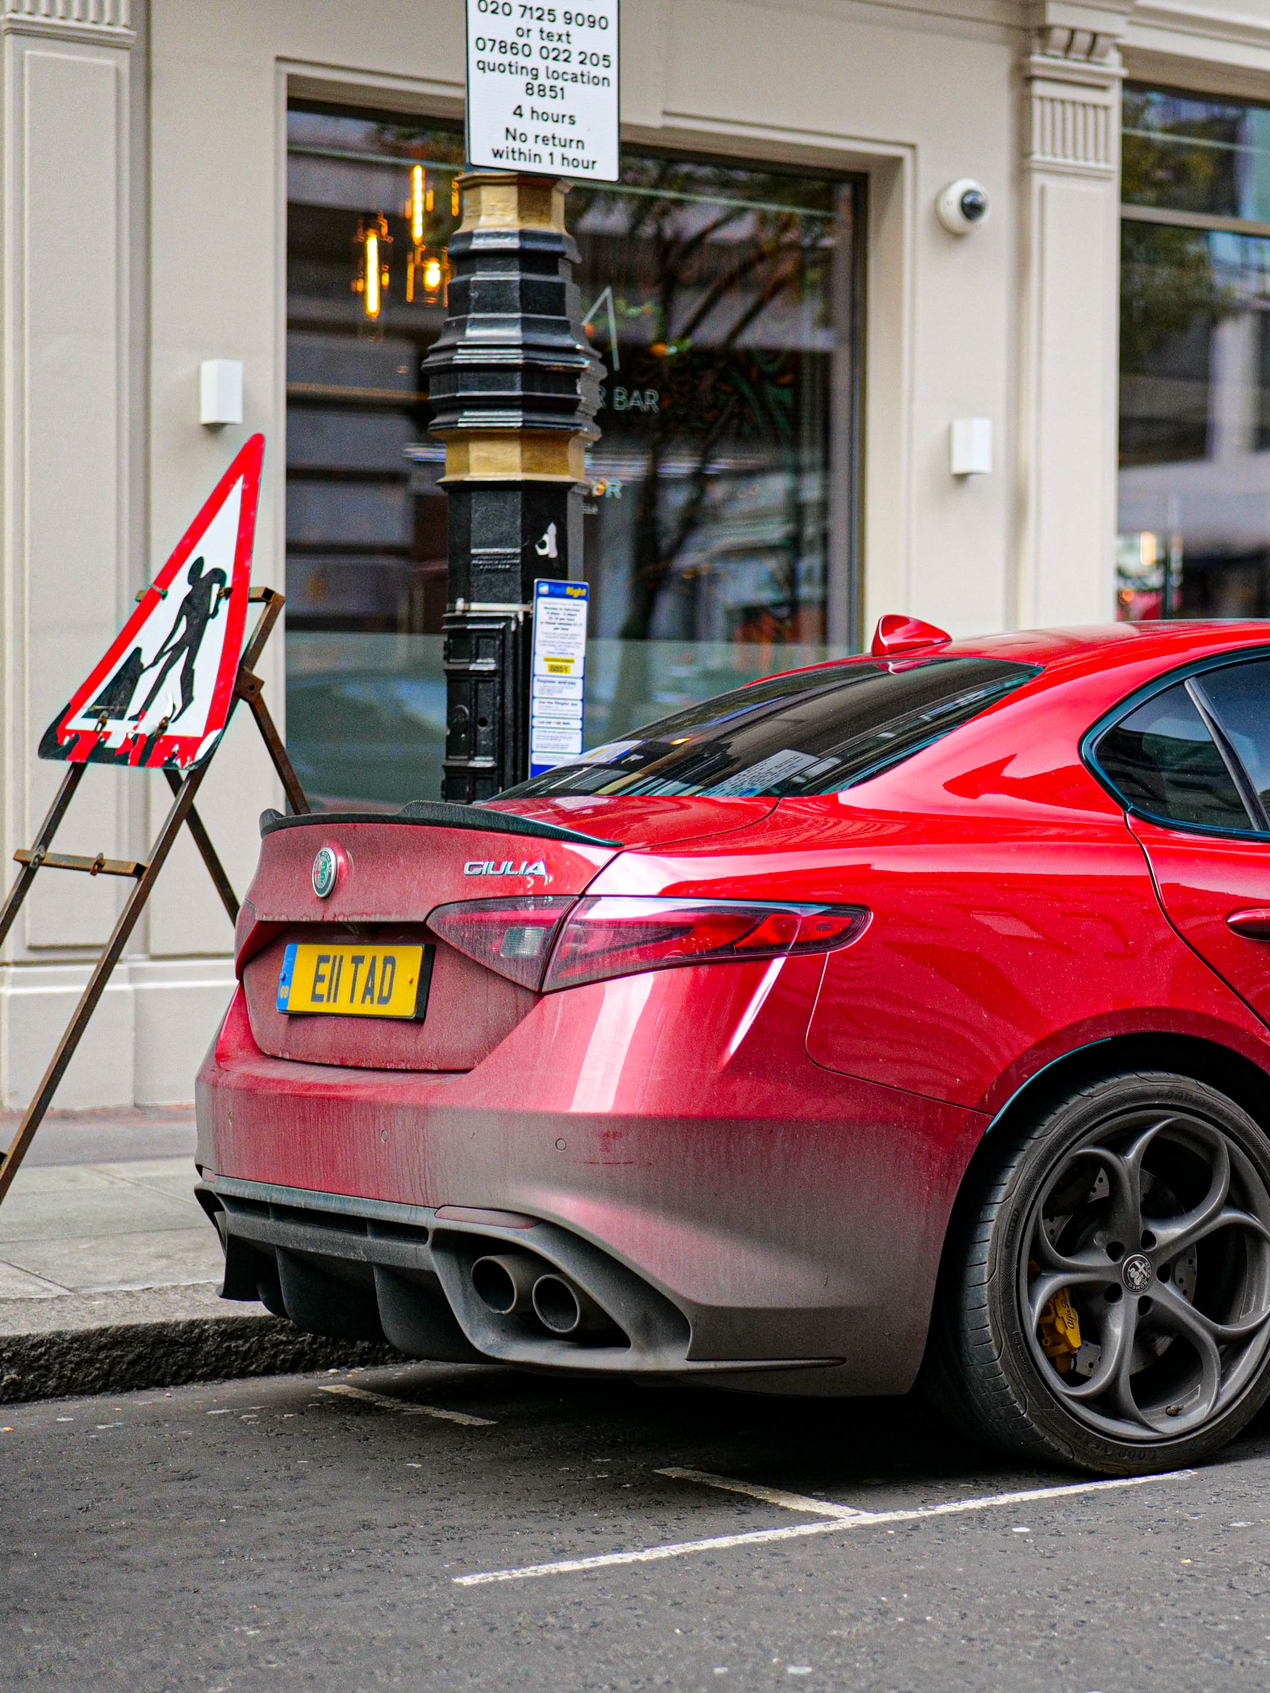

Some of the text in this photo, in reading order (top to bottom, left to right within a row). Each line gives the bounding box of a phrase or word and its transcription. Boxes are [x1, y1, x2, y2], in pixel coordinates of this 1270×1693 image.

[477, 0, 609, 30] 020 7125 9090
[516, 26, 572, 45] or text
[475, 37, 611, 68] 07860 022 205
[476, 59, 611, 87] quoting location
[525, 82, 565, 100] 8851
[512, 104, 576, 125] 4 hours
[505, 127, 585, 150] No return
[492, 147, 597, 170] within 1 hour
[613, 386, 660, 413] BAR
[463, 859, 547, 876] GIULIA
[350, 955, 397, 1005] TAD
